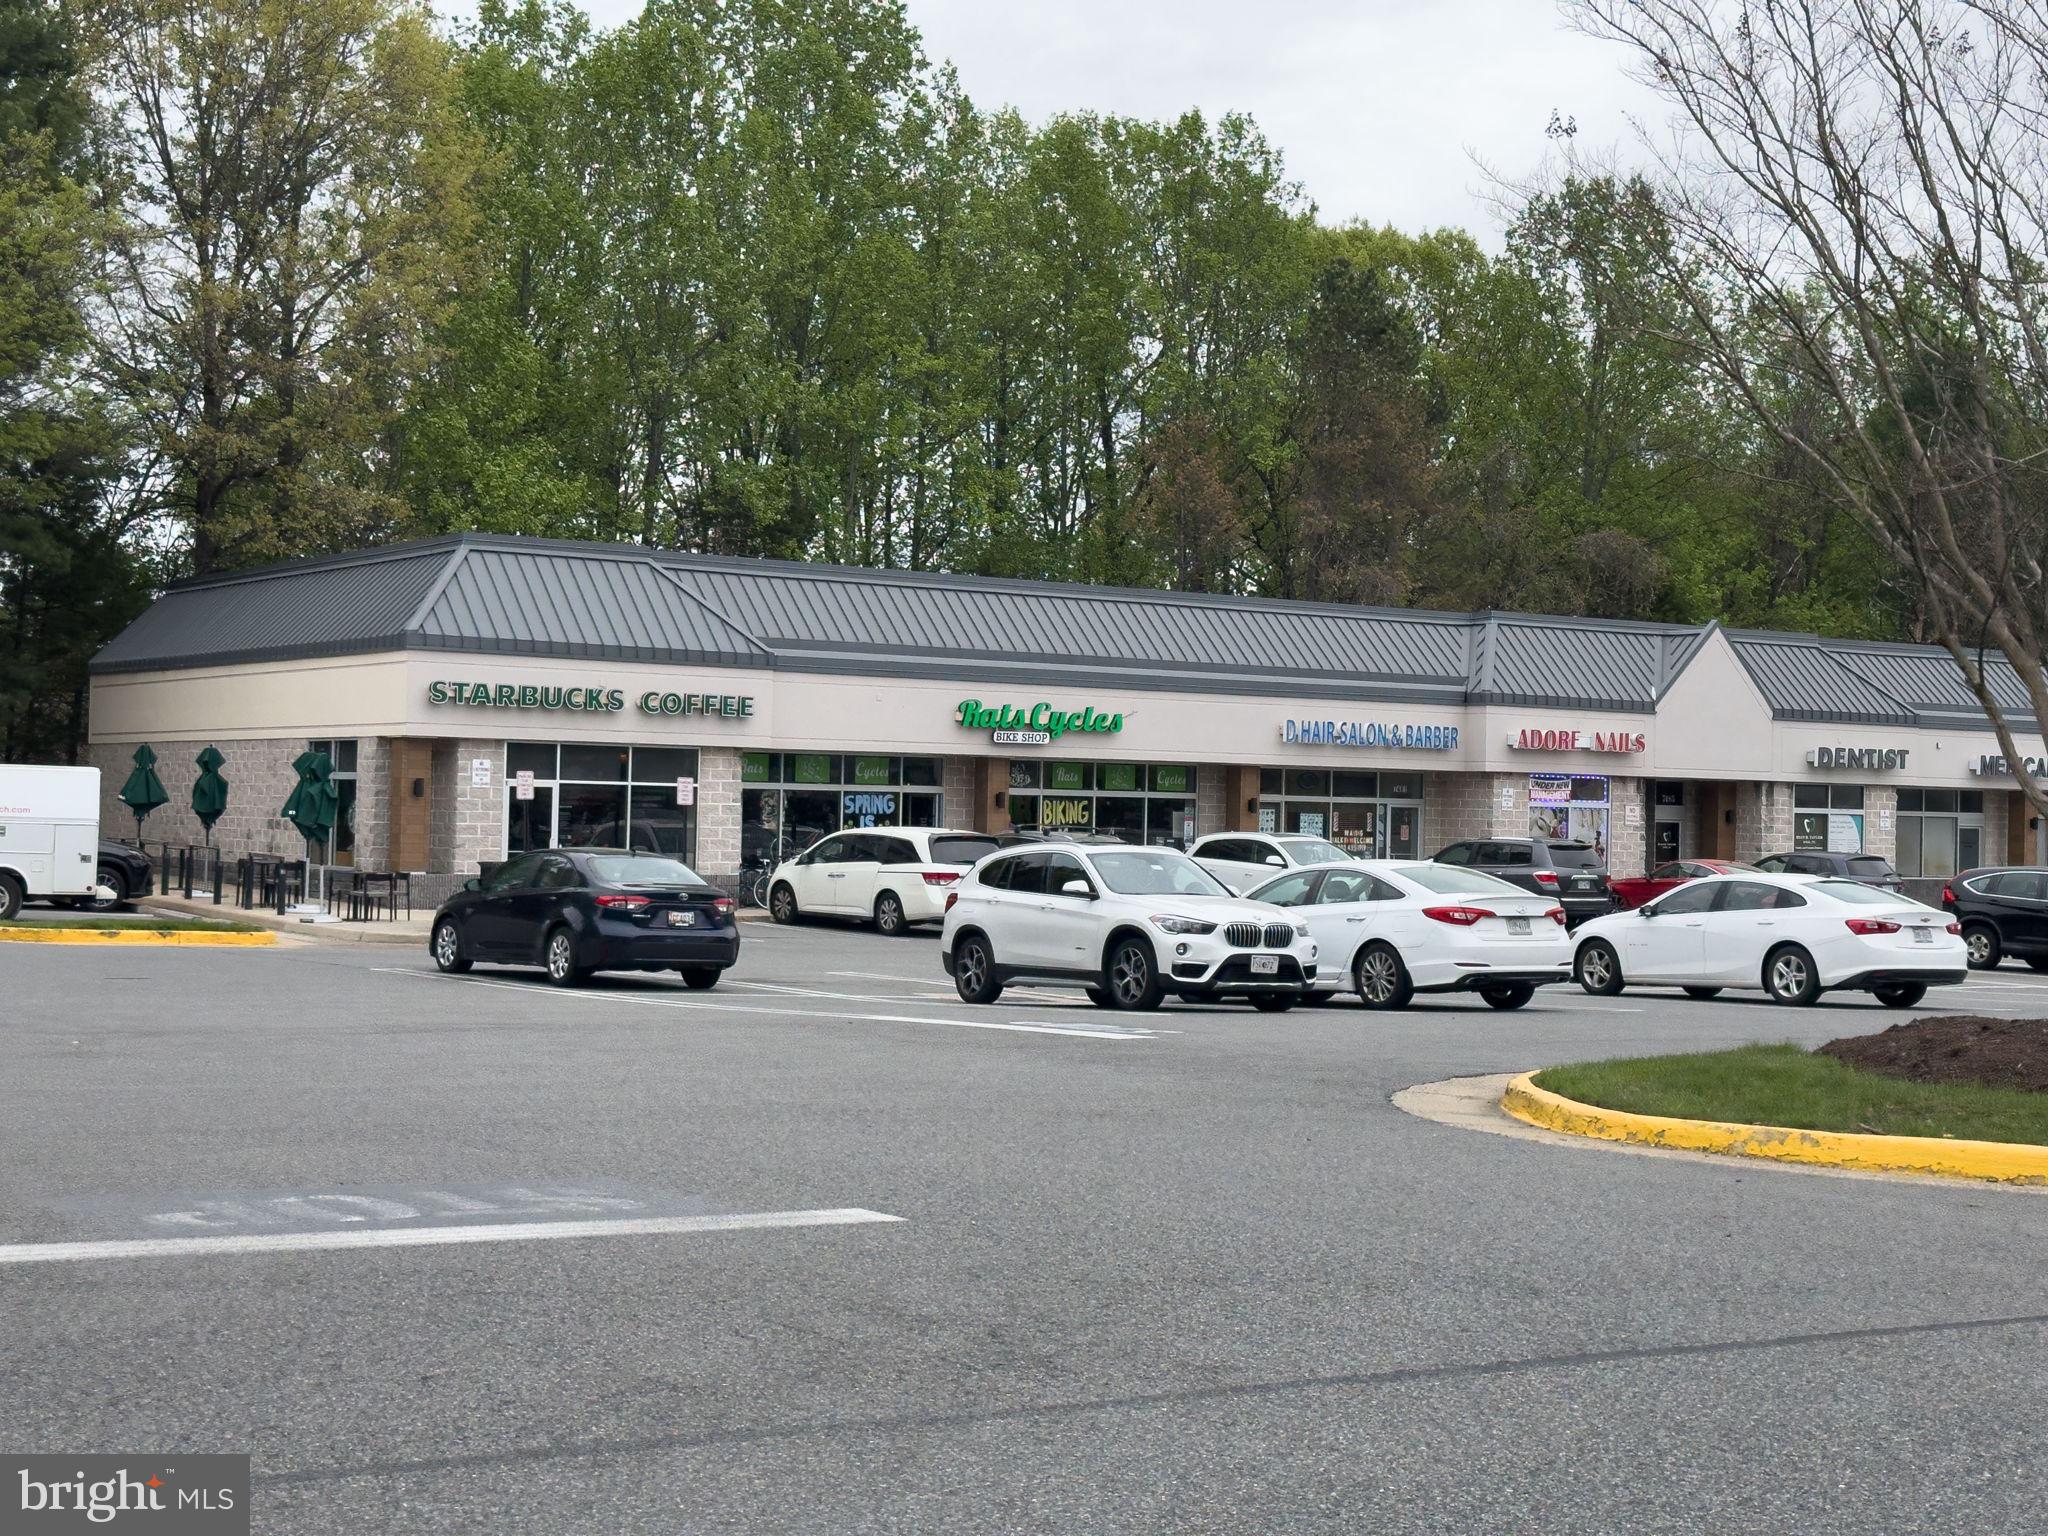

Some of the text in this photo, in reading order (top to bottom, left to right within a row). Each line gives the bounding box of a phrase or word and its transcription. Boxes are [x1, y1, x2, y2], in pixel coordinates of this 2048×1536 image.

[429, 681, 754, 718] STARBUCKS COFFEE
[958, 699, 1125, 740] Rats Cycles
[996, 733, 1048, 743] BIKE SHOP
[1300, 720, 1335, 743] HAIR
[1339, 722, 1388, 747] SALON
[1391, 724, 1402, 747] &
[1405, 725, 1459, 750] BARBER
[1517, 729, 1646, 753] ADORE NAILS
[1817, 746, 1910, 770] DENTIST
[1980, 755, 2048, 778] MECA
[855, 763, 889, 780] Cycles
[1056, 766, 1078, 782] Rats
[1157, 770, 1187, 786] Cycles
[1530, 790, 1571, 800] MANAGEMENT
[1531, 780, 1570, 790] UNDER NEW
[844, 794, 896, 815] SPRING
[1042, 800, 1090, 825] BIKING
[859, 815, 875, 828] IS
